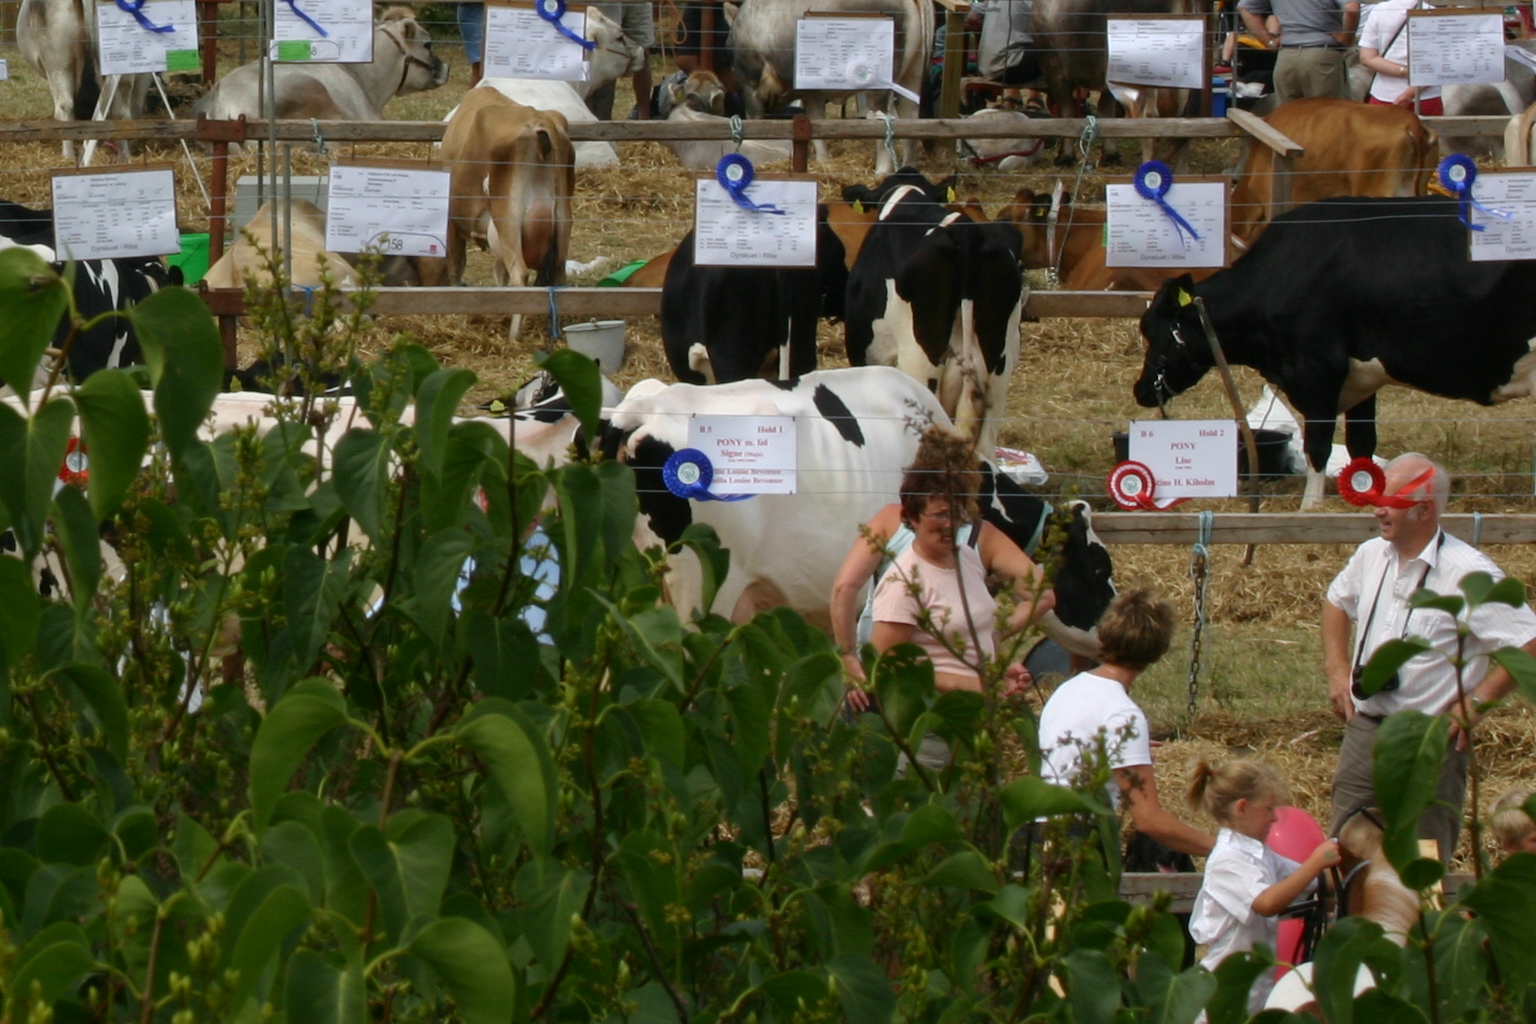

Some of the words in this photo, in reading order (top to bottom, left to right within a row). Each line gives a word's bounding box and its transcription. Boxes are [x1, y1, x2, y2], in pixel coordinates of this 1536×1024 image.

[387, 239, 403, 250] 158
[757, 426, 777, 434] Hold
[716, 438, 742, 447] PONY
[1170, 442, 1196, 450] PONY
